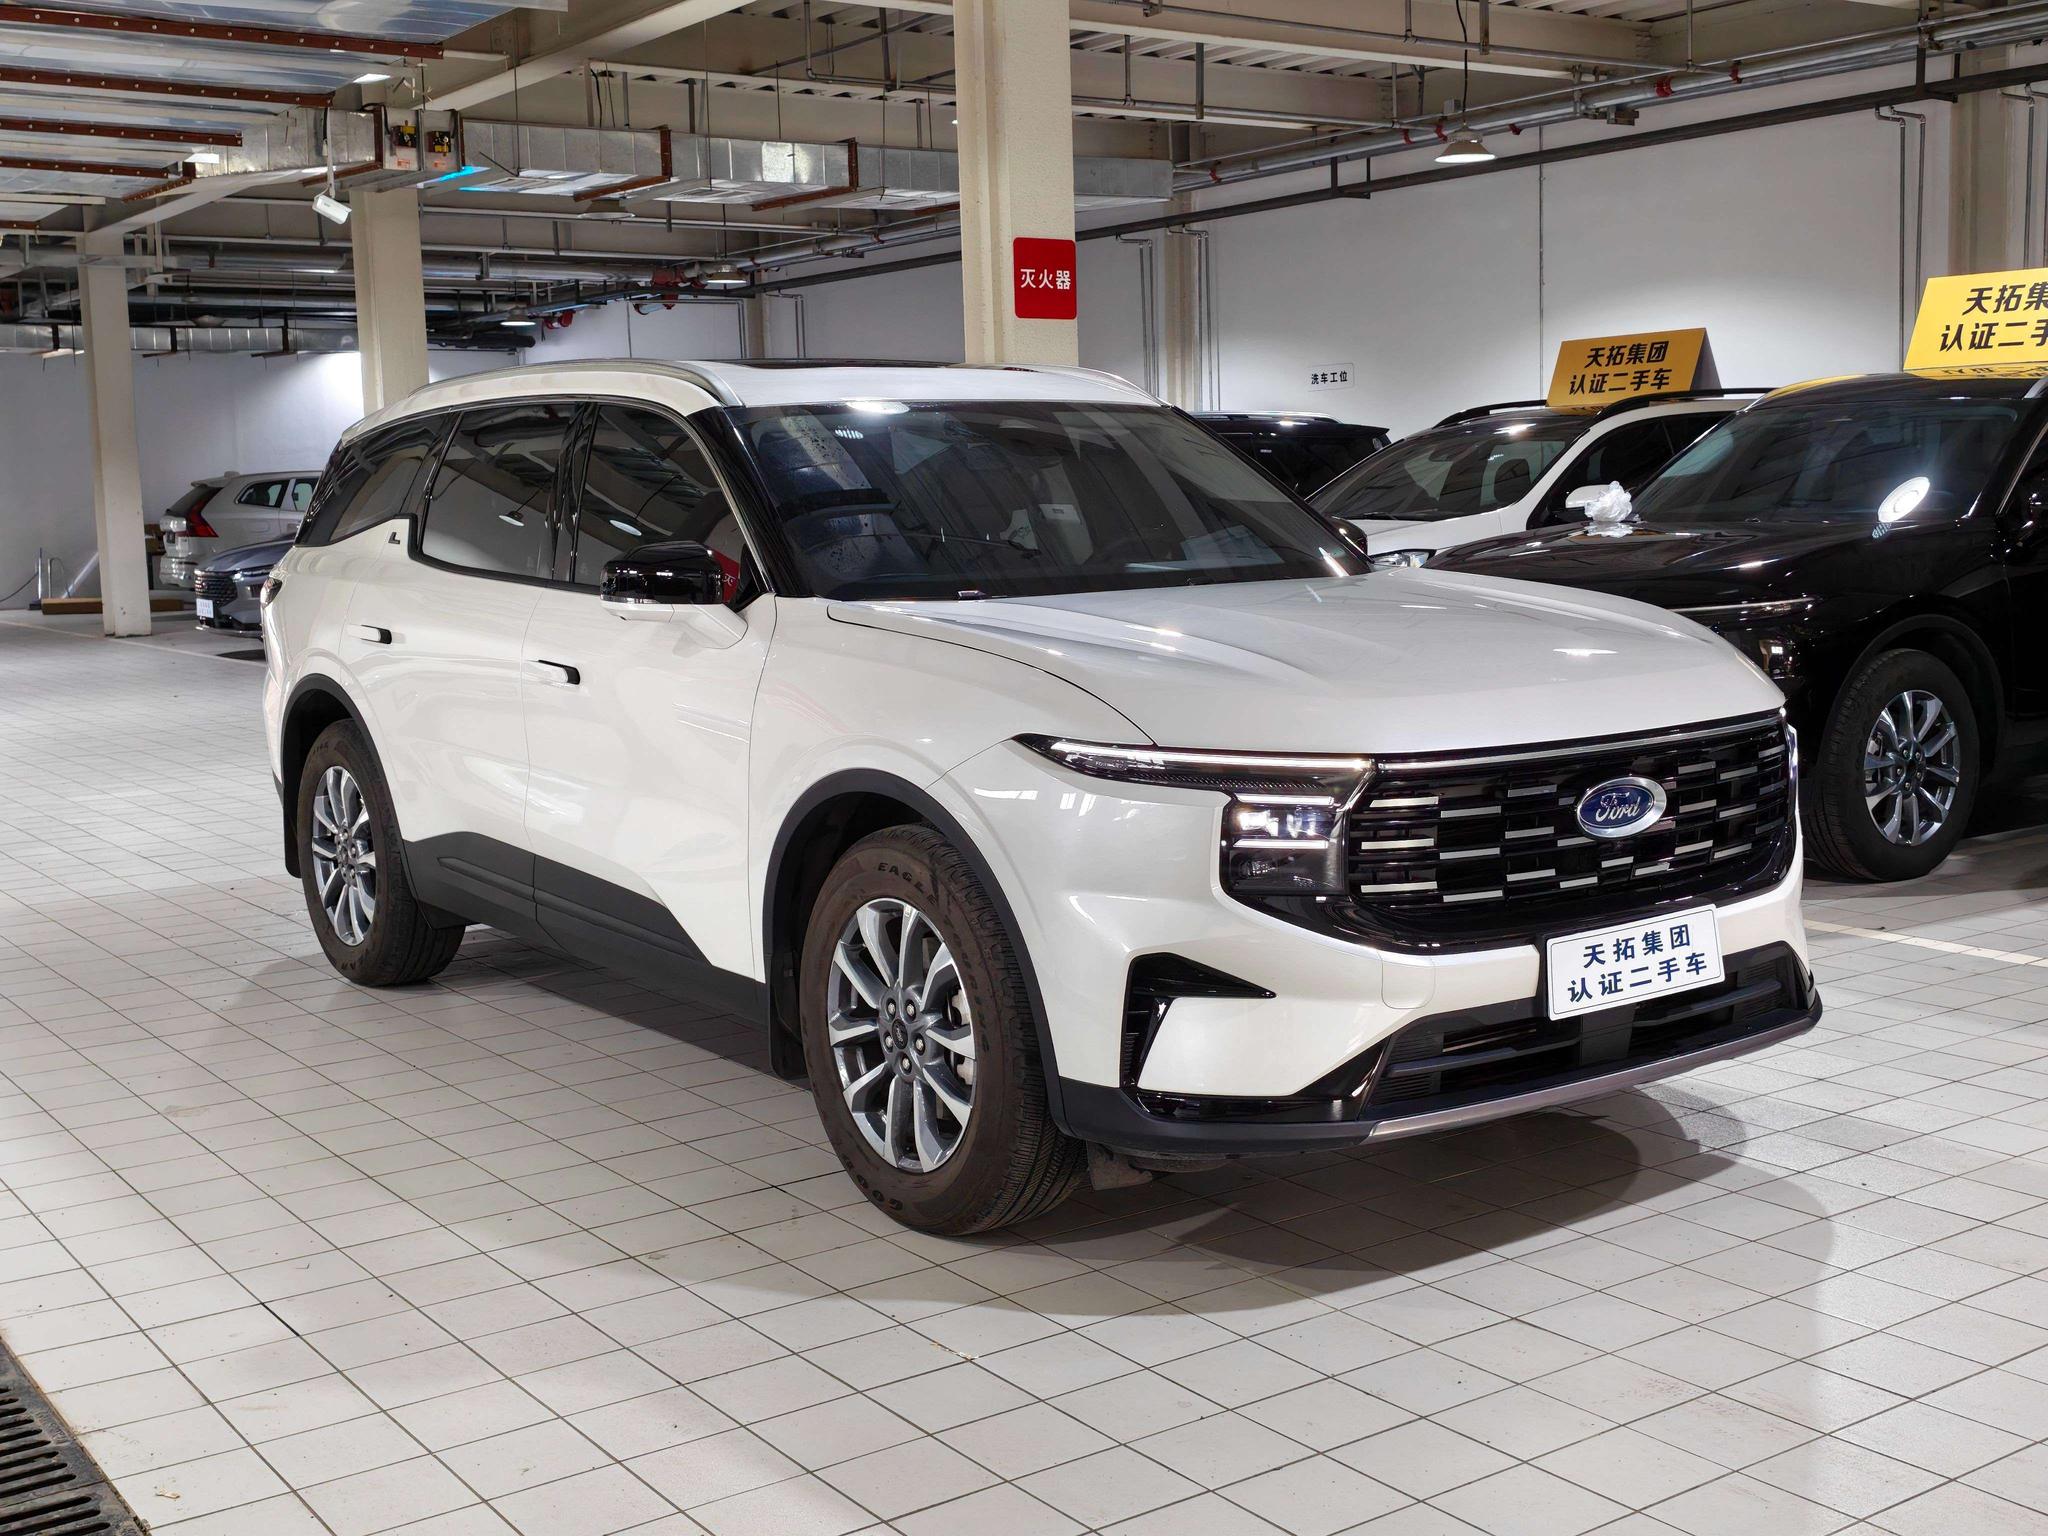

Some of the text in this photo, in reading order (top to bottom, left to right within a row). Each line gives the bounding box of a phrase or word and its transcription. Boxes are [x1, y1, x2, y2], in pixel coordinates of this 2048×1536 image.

[1020, 268, 1071, 290] 灭火器
[1584, 341, 1669, 368] 天拓集团
[1311, 370, 1348, 384] 洗车工位
[1569, 368, 1672, 395] 认证二手车
[1595, 791, 1641, 822] Ford
[877, 861, 937, 905] EAGLE
[1583, 923, 1691, 969] 天拓集团
[1567, 952, 1707, 1003] 认证二手车
